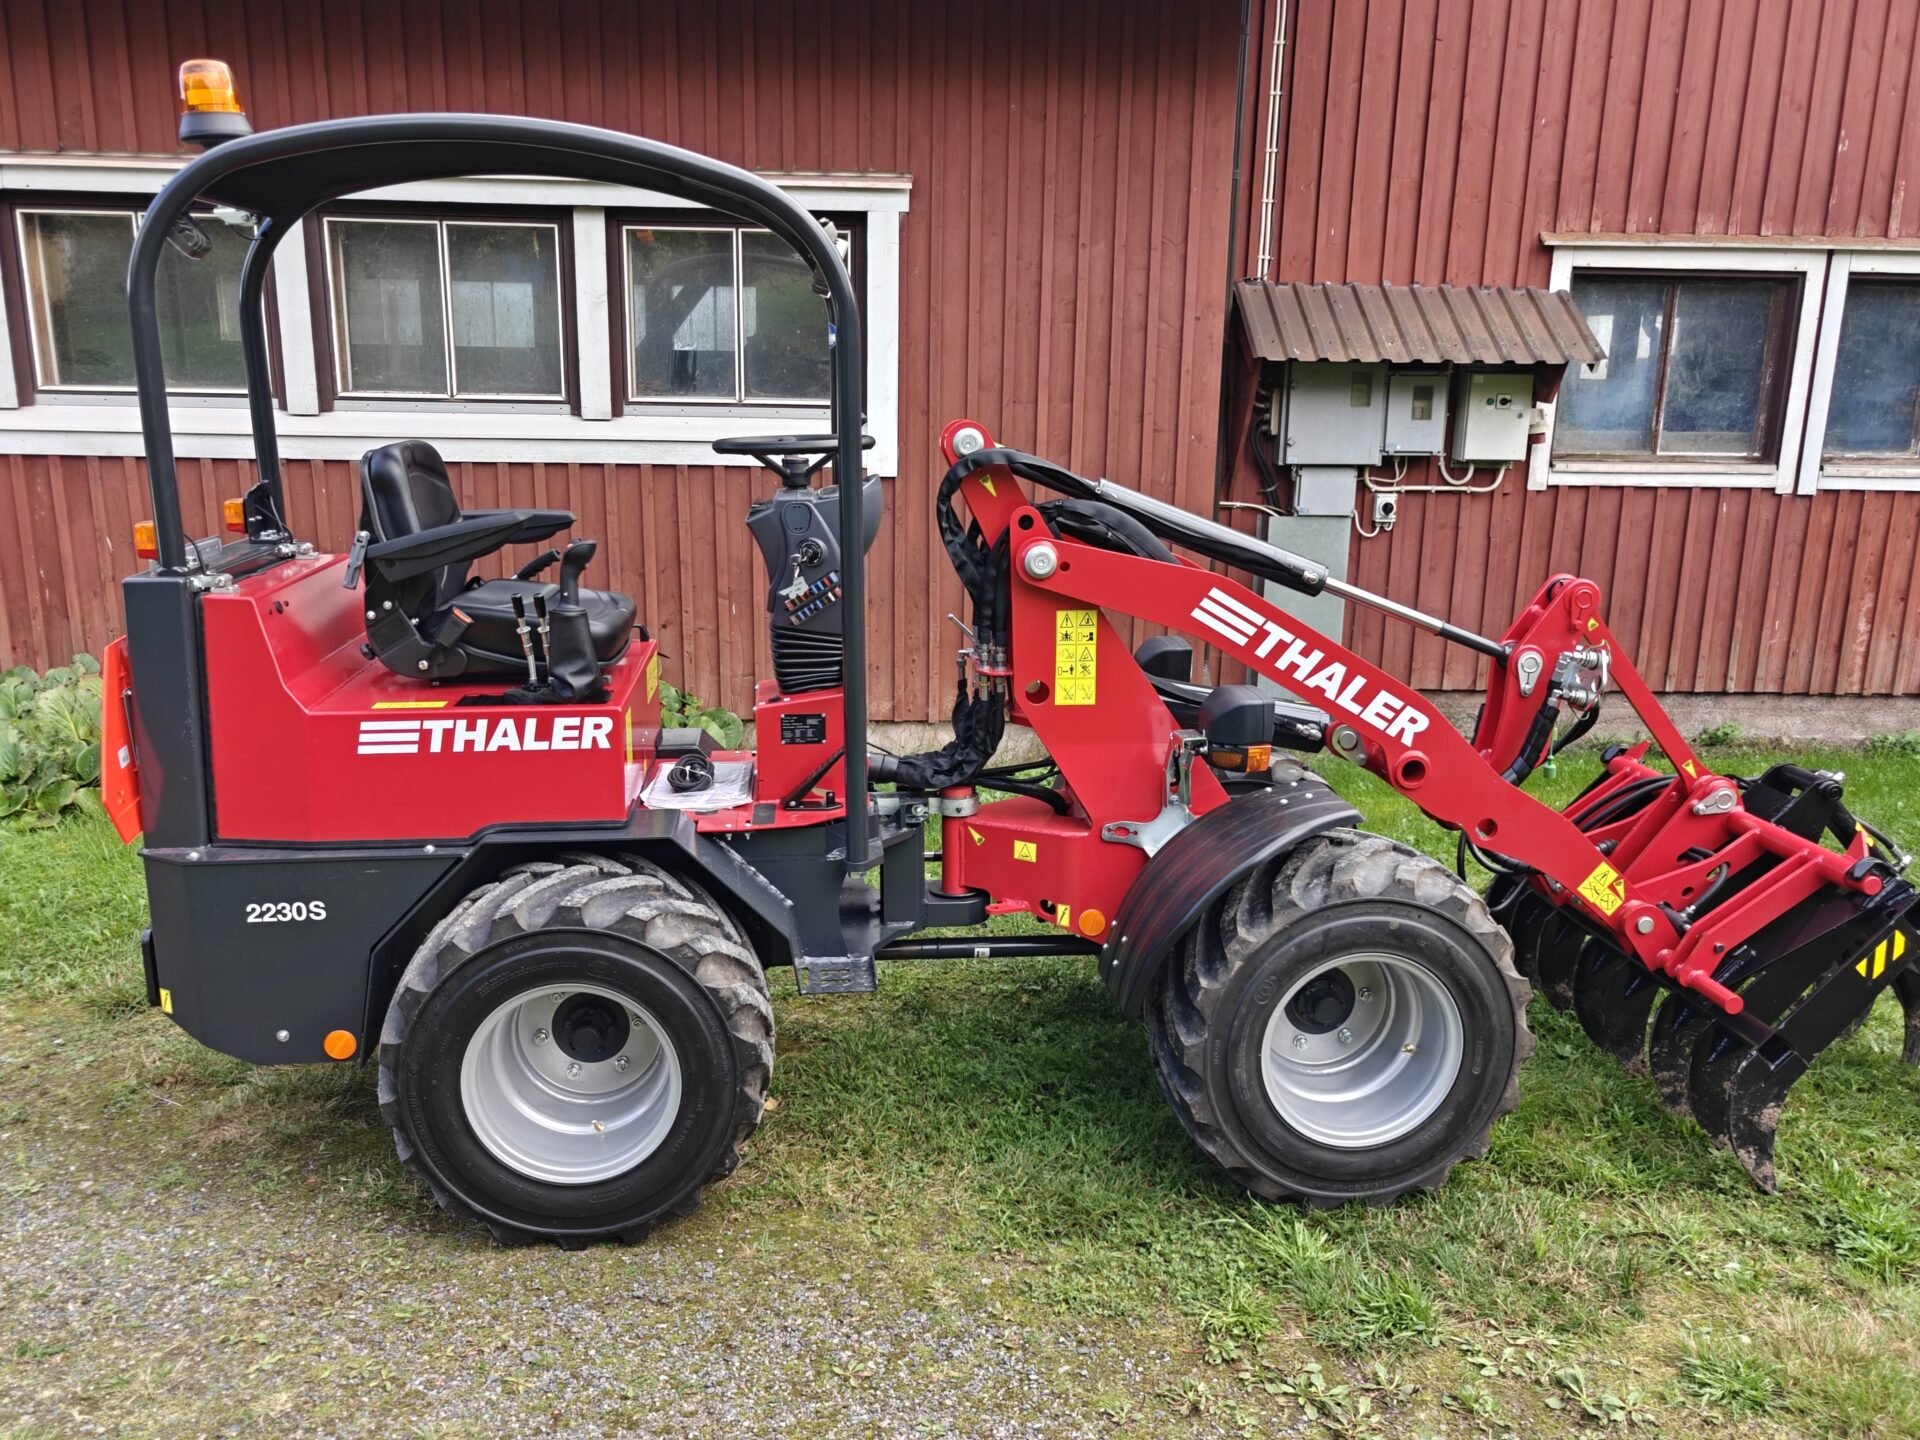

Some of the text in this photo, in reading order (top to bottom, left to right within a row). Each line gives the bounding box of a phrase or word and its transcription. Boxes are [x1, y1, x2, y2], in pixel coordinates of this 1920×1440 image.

[1254, 620, 1430, 747] THALER
[422, 716, 614, 753] THALER
[246, 901, 327, 922] 2230S
